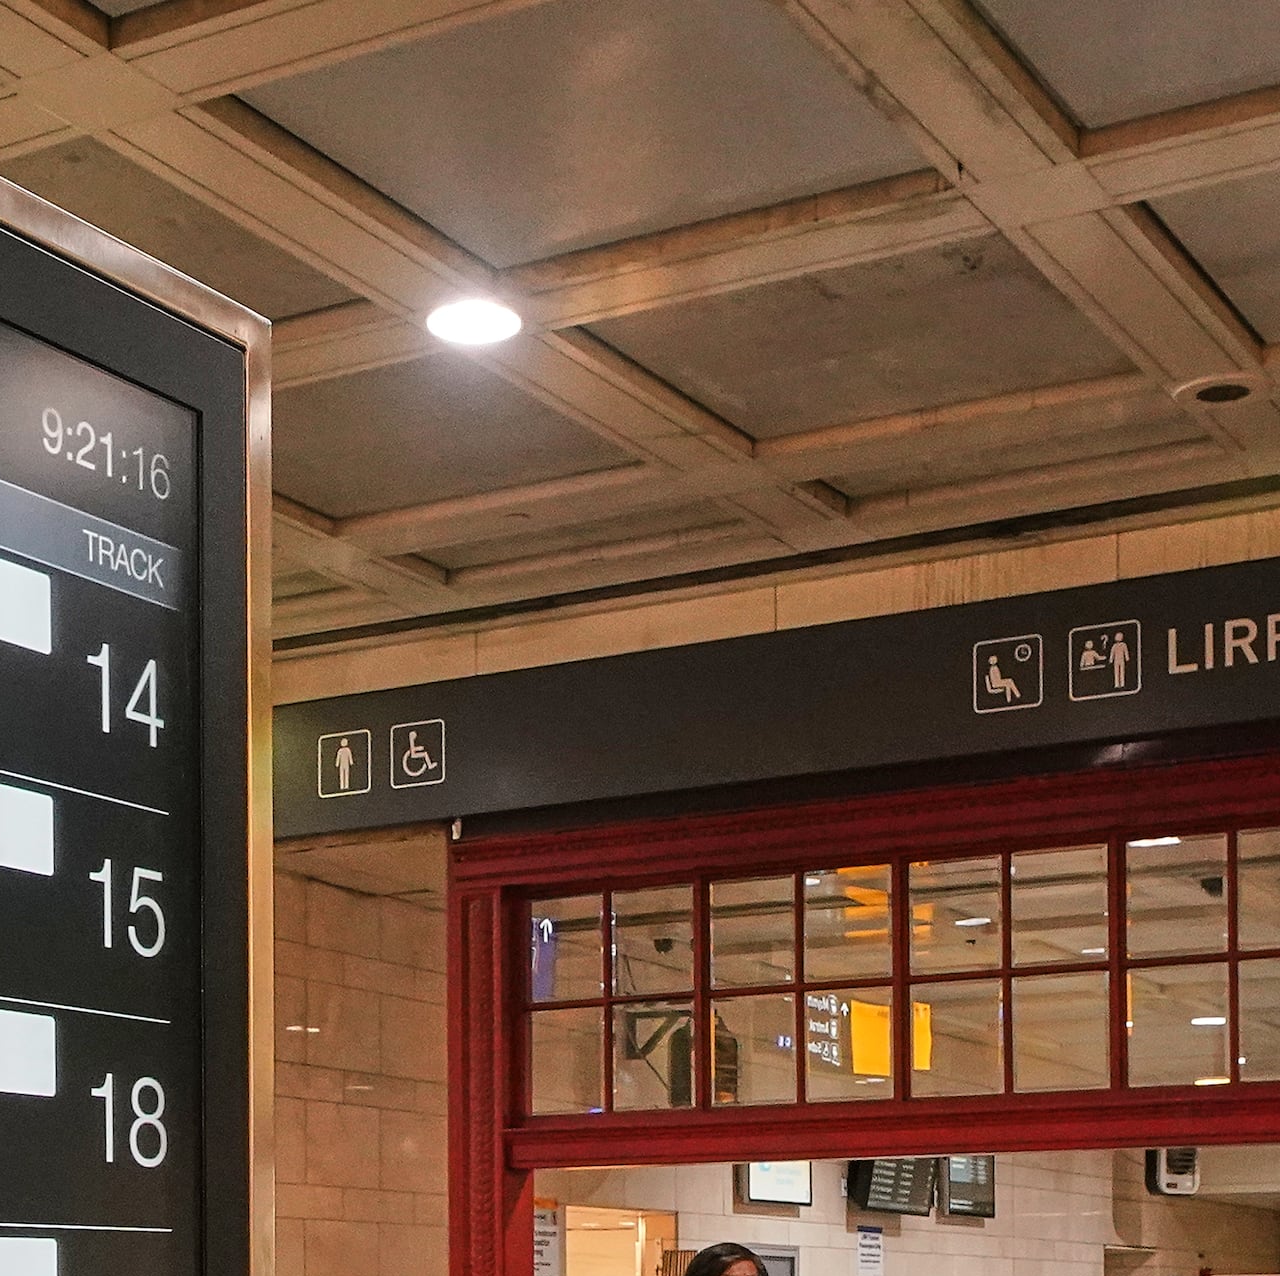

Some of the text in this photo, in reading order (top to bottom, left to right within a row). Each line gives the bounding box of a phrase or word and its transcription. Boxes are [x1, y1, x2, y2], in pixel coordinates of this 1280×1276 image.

[42, 407, 171, 500] 9:21:16
[82, 529, 163, 587] TRACK
[87, 644, 164, 747] 14
[90, 859, 165, 957] 15
[91, 1073, 167, 1167] 18
